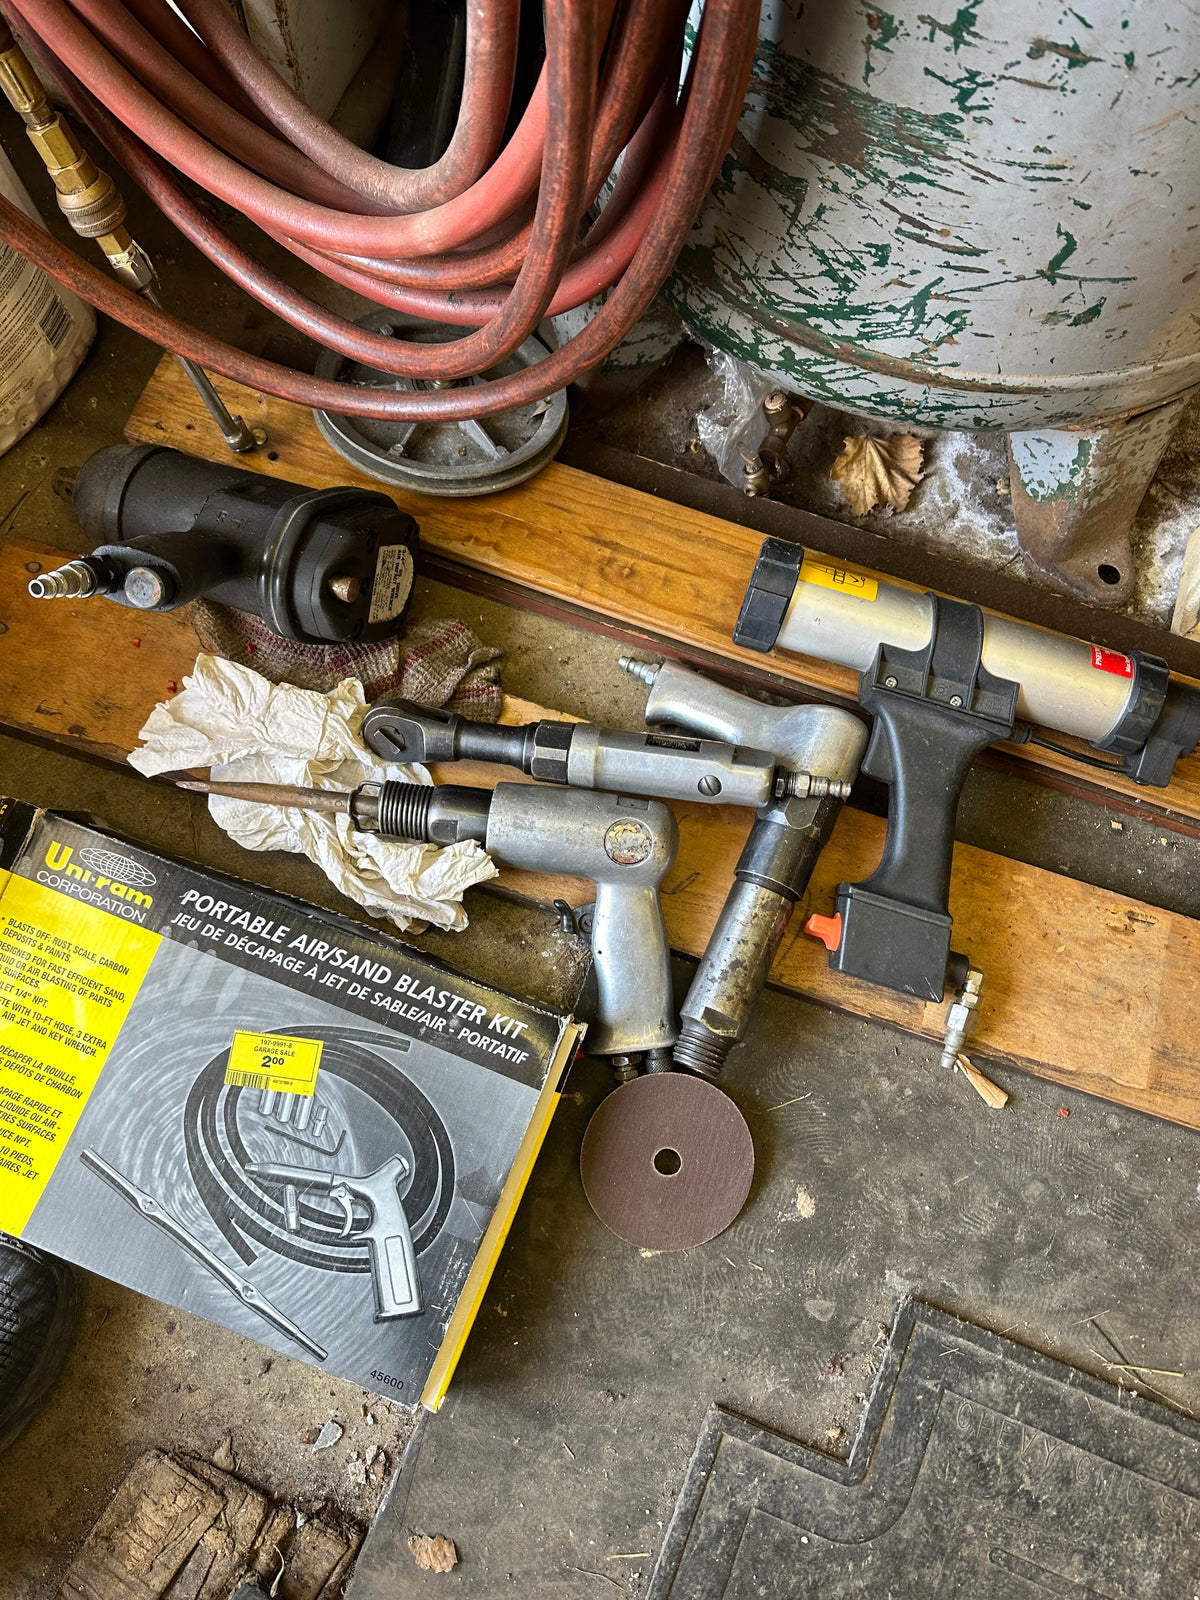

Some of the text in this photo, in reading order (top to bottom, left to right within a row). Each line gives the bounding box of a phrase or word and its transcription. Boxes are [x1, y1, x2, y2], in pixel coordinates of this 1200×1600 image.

[36, 870, 147, 924] CORPORATION
[3, 927, 38, 947] DEPOSITS
[45, 945, 71, 963] PAINTS.
[8, 918, 130, 975] BLASTS OFF: RUST, SCALE, CARBON
[2, 966, 40, 989] SURFACES.
[32, 955, 48, 968] FOR
[47, 962, 67, 976] FAST
[67, 971, 104, 992] EFFICIENT
[104, 986, 125, 1003] SAND,
[181, 889, 529, 1040] PORTABLE AIR/SAND BLASTER KIT
[16, 960, 26, 971] OR
[26, 966, 41, 977] AIR
[41, 971, 77, 993] BLASTING
[78, 987, 89, 997] OF
[88, 992, 113, 1008] PARTS
[32, 995, 48, 1009] NPT.
[170, 912, 202, 932] JEU
[200, 923, 225, 942] DE
[224, 936, 306, 974] DÉCAPAGE
[303, 963, 318, 980] À
[319, 971, 348, 991] JET
[346, 982, 371, 1001] DE
[370, 991, 447, 1032] SABLE/AIR
[457, 1027, 529, 1065] PORTATIF
[2, 1011, 97, 1058] AIR JET AND KEY WRENCH.
[12, 1002, 31, 1016] WITH
[33, 1011, 53, 1026] 10-FT
[54, 1020, 74, 1037] HOSE,
[76, 1030, 82, 1039] 3
[82, 1034, 107, 1050] EXTRA
[254, 1046, 279, 1055] GARAGE
[4, 1059, 34, 1078] DÉPÔTS
[34, 1073, 46, 1083] DE
[45, 1078, 83, 1099] CHARBON
[32, 1060, 44, 1070] LA
[43, 1064, 76, 1086] ROUILLE,
[0, 1099, 31, 1118] LIQUIDE
[30, 1112, 43, 1123] OU
[41, 1118, 57, 1130] AIR
[22, 1096, 52, 1115] RAPIDE
[51, 1109, 63, 1119] ET
[9, 1150, 34, 1168] PIEDS,
[13, 1134, 31, 1148] NPT.
[22, 1169, 39, 1180] JET
[370, 1369, 404, 1390] 45600
[956, 1402, 1060, 1467] CHEVY
